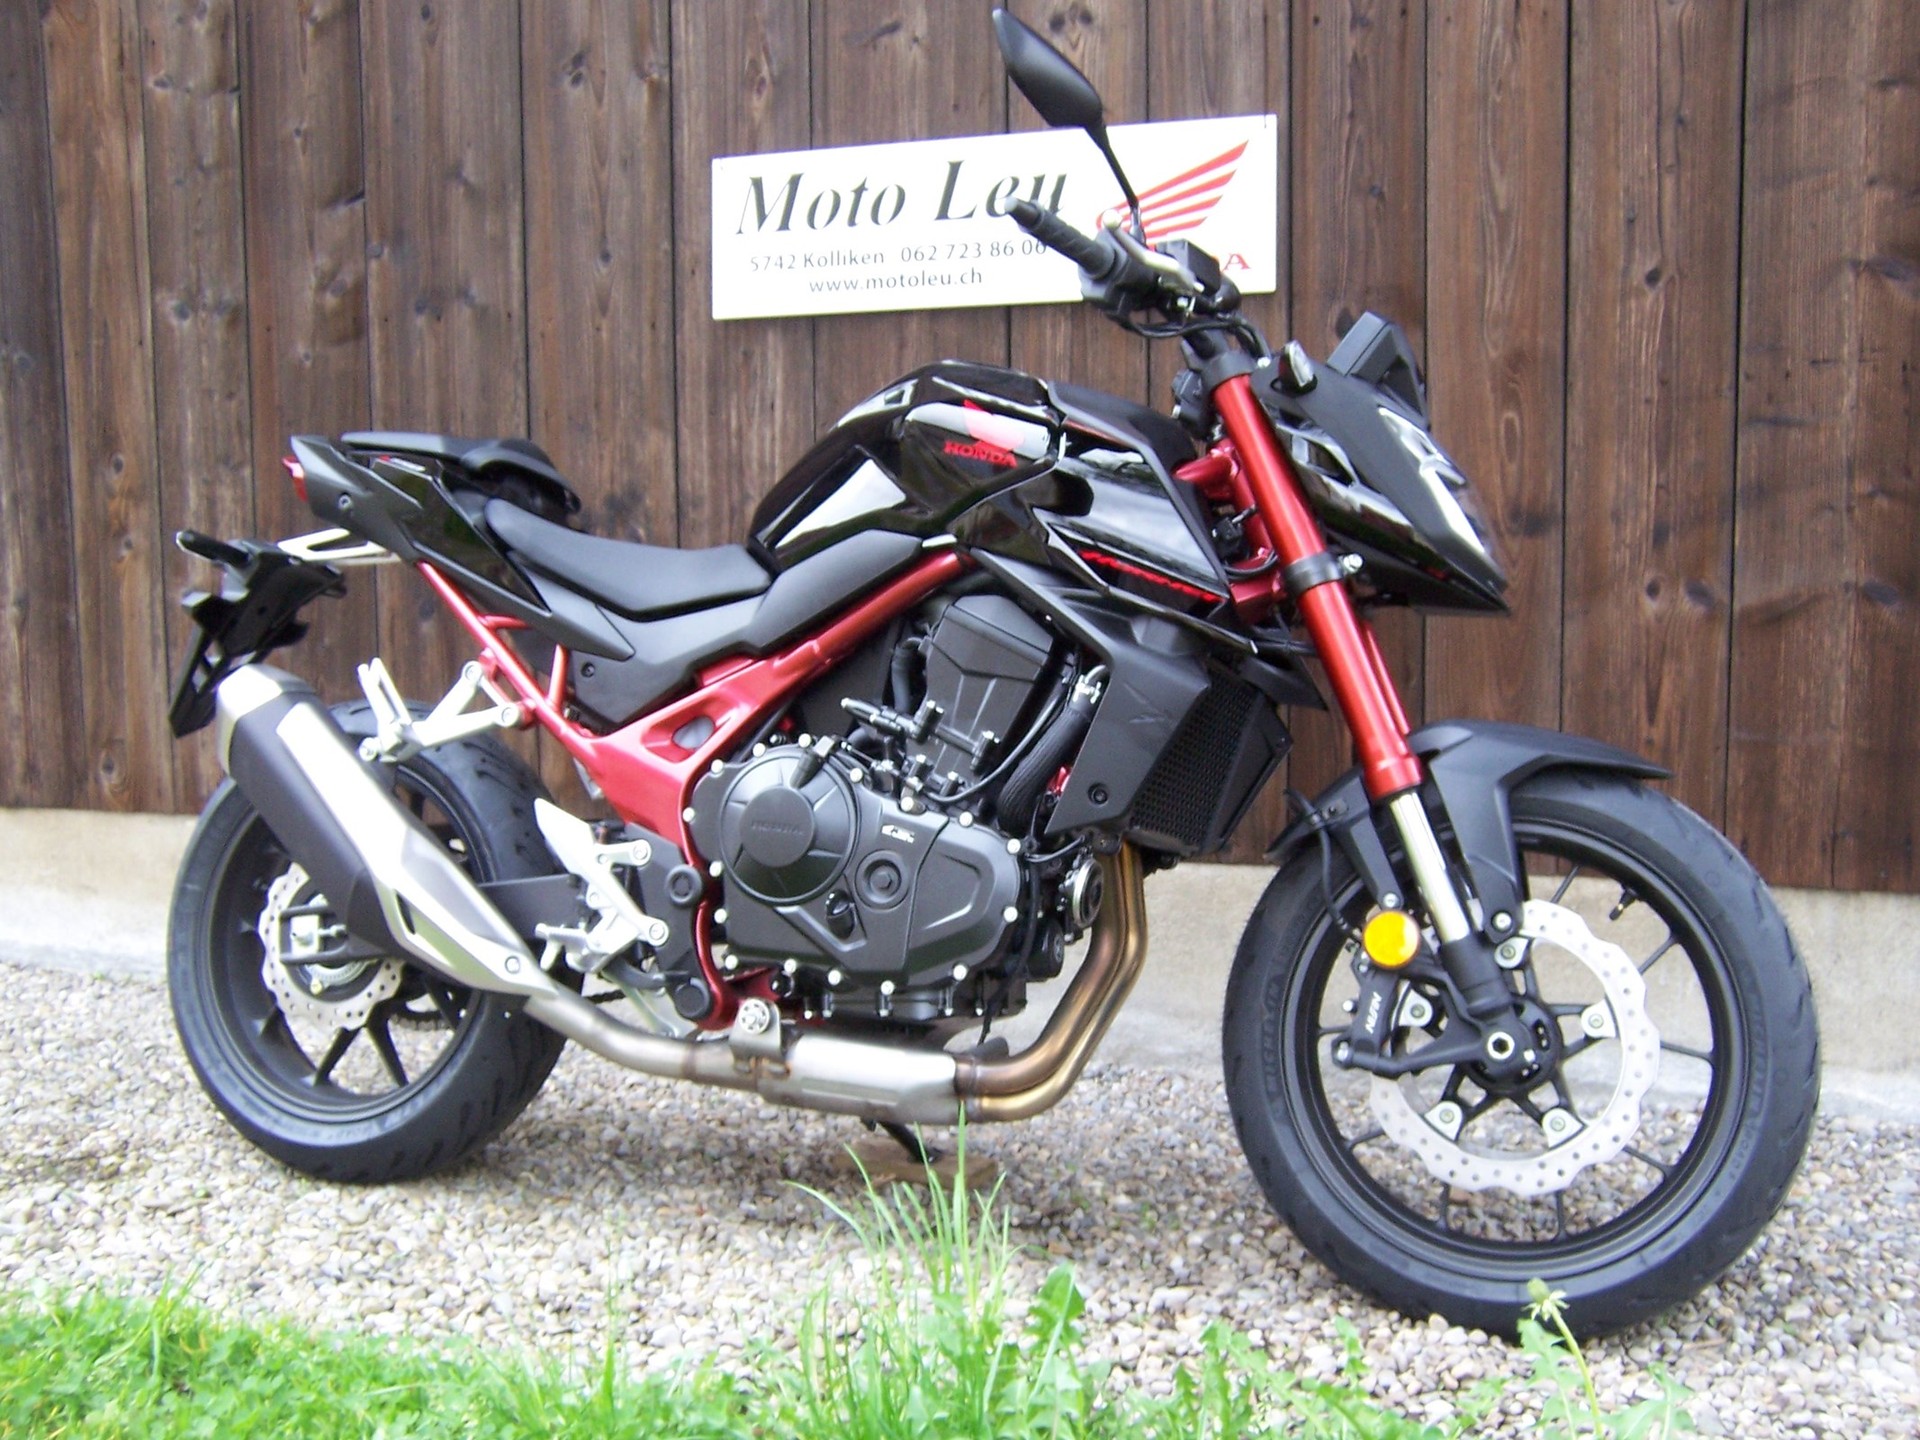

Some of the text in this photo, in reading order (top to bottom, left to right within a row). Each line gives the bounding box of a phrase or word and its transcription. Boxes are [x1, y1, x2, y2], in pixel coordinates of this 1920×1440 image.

[736, 160, 1067, 235] Moto Leu
[750, 254, 796, 272] 5742
[900, 245, 938, 263] 062
[946, 242, 982, 260] 723
[990, 240, 1014, 257] 86
[809, 267, 983, 293] www.motoleu.ch
[943, 439, 1018, 469] HONDA
